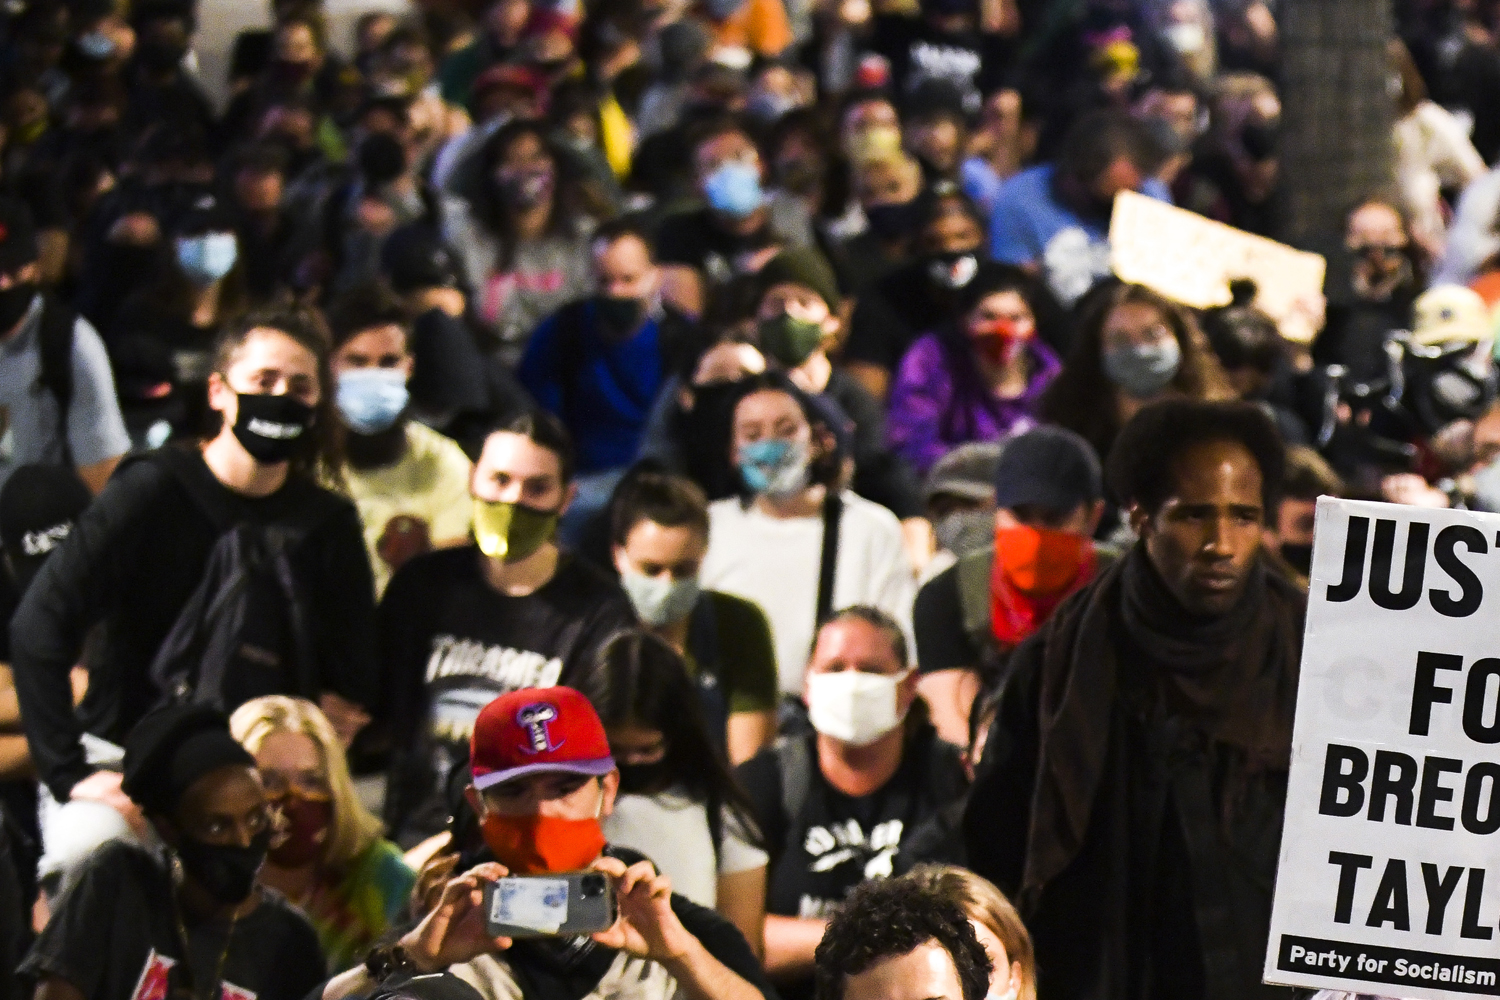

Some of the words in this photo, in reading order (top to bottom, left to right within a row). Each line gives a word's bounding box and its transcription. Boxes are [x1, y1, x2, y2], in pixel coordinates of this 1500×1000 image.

[1289, 944, 1351, 973] Party
[1357, 953, 1388, 974] for
[1393, 958, 1496, 987] Socialism
